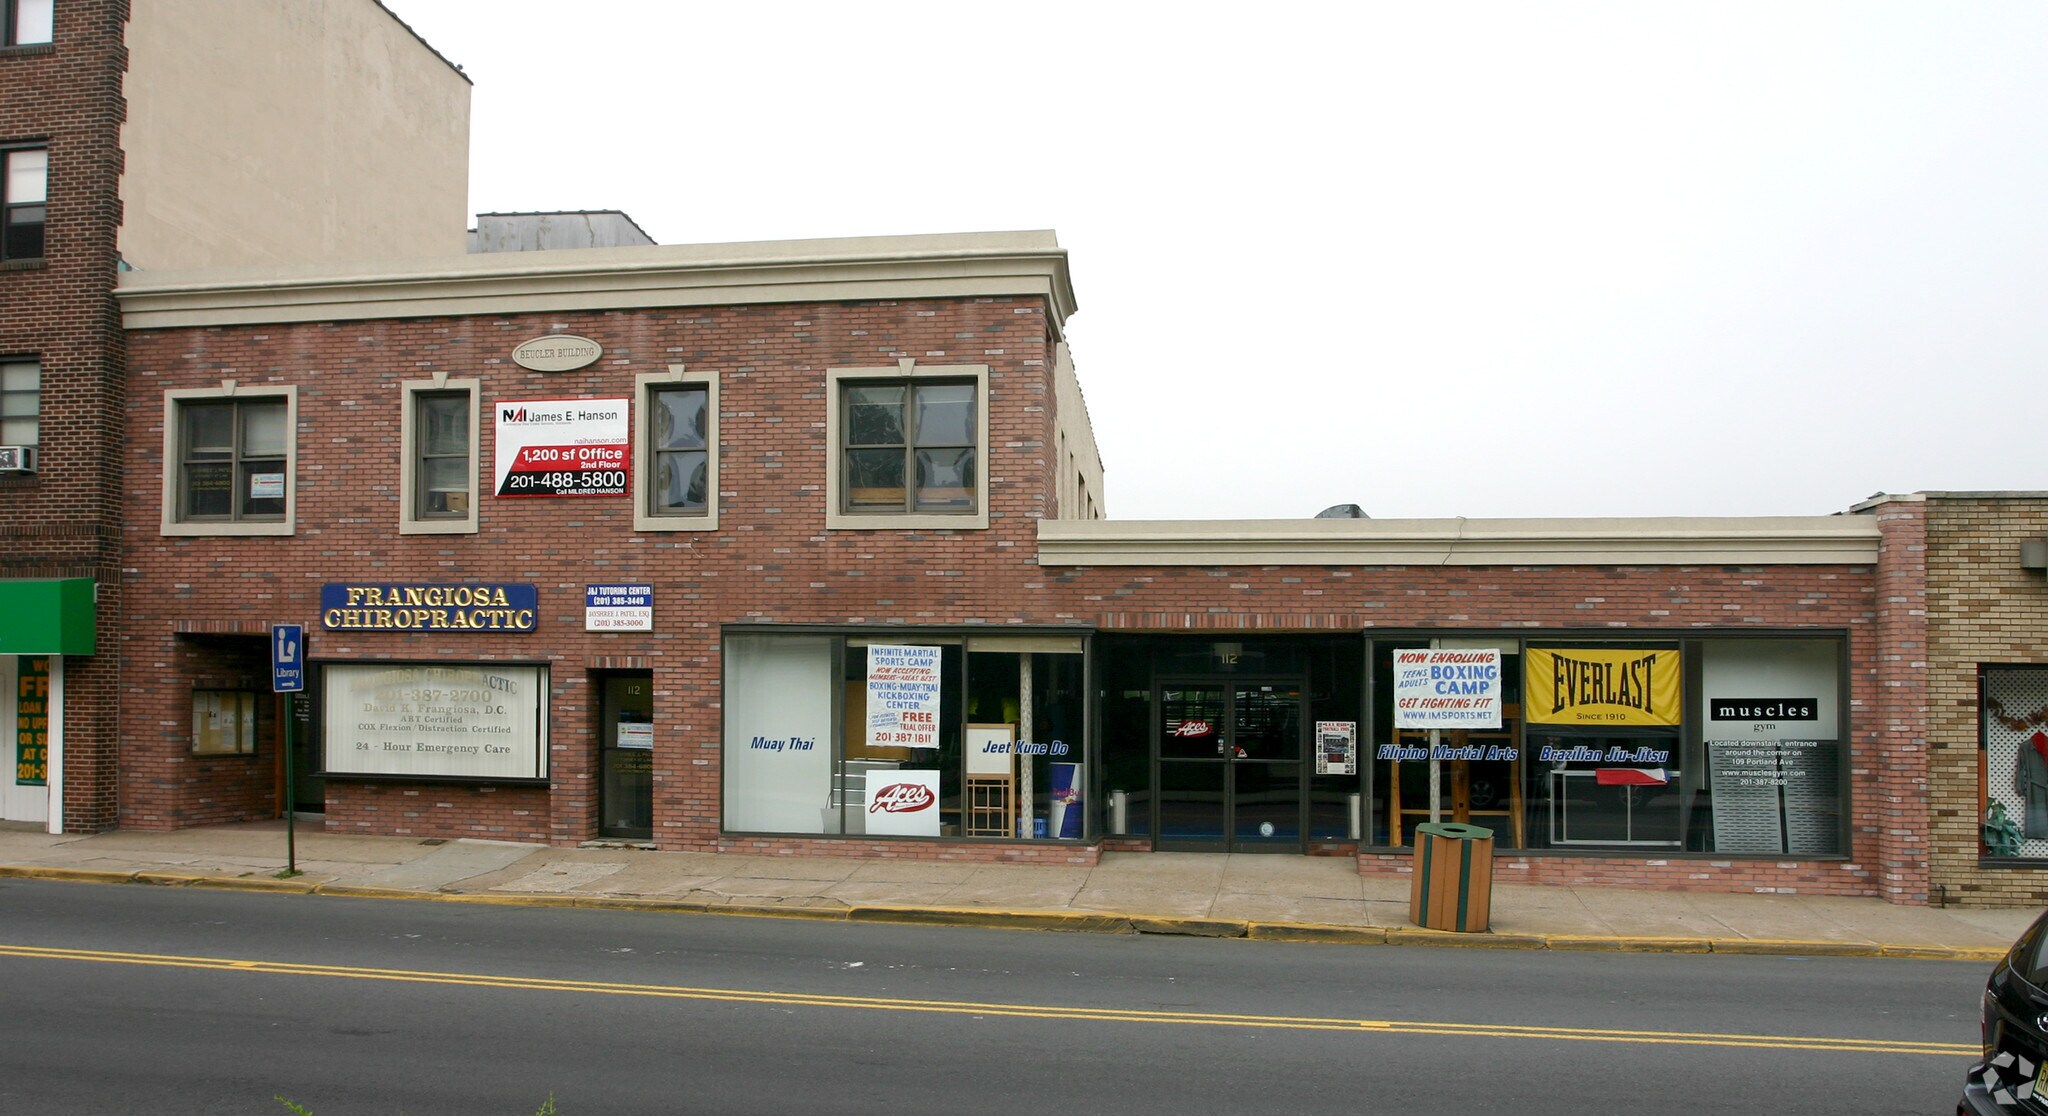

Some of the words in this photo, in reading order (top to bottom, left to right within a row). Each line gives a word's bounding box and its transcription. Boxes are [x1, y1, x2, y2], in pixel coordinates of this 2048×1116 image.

[520, 349, 555, 359] BEUCLER
[557, 347, 594, 357] BUILDING
[503, 406, 527, 422] NAI
[529, 412, 562, 422] James
[565, 411, 575, 421] E.
[578, 410, 618, 421] Hanson
[574, 437, 627, 445] naihanson.com
[522, 449, 559, 462] 1,200
[561, 449, 576, 461] sf
[578, 447, 623, 460] Office
[580, 461, 597, 469] 2nd
[598, 461, 621, 469] Floor
[510, 471, 626, 487] 201-488-5800
[346, 587, 510, 607] FRANGIOSA
[599, 586, 628, 596] TUTORING
[628, 586, 651, 596] CENTER
[593, 596, 610, 606] (201)
[611, 596, 645, 605] 385-3449
[324, 609, 533, 629] CHIROPRACTIC
[593, 619, 610, 627] (201)
[871, 648, 902, 657] INFINITE
[903, 649, 938, 658] MARTIAL
[1222, 653, 1238, 664] 112
[1397, 653, 1428, 663] NOW
[1430, 653, 1495, 663] ENROLLING
[875, 657, 905, 667] SPORTS
[908, 658, 934, 667] CAMP
[276, 667, 300, 679] Library
[892, 667, 931, 675] ACCEPTING
[1402, 669, 1428, 679] TEENS
[1430, 665, 1497, 680] BOXING
[1398, 678, 1428, 689] ADULTS
[1435, 681, 1490, 695] CAMP
[1551, 652, 1657, 715] EVERLAST
[627, 685, 640, 695] 112
[877, 692, 930, 701] KICKBOXING
[18, 701, 42, 714] LOAN
[364, 703, 396, 713] David
[417, 704, 480, 716] Frangiosa,
[484, 705, 507, 715] D.C.
[886, 701, 920, 710] CENTER
[1398, 698, 1419, 709] GET
[1420, 698, 1471, 709] FIGHTING
[1473, 698, 1493, 709] FIT
[1403, 711, 1493, 719] WWW.IMSPORTS.NET
[1719, 703, 1809, 717] muscles
[17, 717, 29, 729] NO
[424, 716, 463, 724] Certified
[902, 712, 932, 723] FREE
[358, 723, 376, 731] COX
[471, 725, 512, 734] Certified
[900, 723, 917, 732] TRIAL
[917, 724, 936, 732] OFFER
[1174, 721, 1209, 737] Aces
[1753, 723, 1776, 732] gym
[19, 732, 32, 744] OR
[1740, 740, 1784, 748] downstairs,
[1785, 740, 1818, 748] entrance
[356, 742, 369, 750] 24
[383, 742, 412, 752] Hour
[416, 742, 479, 755] Emergency
[484, 743, 511, 754] Care
[751, 737, 785, 752] Muay
[789, 737, 816, 751] Thai
[982, 740, 1012, 754] Jeet
[1015, 740, 1048, 755] Kune
[1050, 740, 1069, 756] Do
[22, 748, 36, 760] AT
[1377, 744, 1429, 763] Filipino
[1430, 744, 1485, 760] Martial
[1486, 745, 1518, 761] Arts
[1539, 746, 1603, 762] Brazilian
[1604, 746, 1669, 763] Jiu-Jitsu
[17, 763, 47, 779] 201-3
[1721, 769, 1806, 777] www.musclesgym.com
[869, 783, 930, 814] Aces
